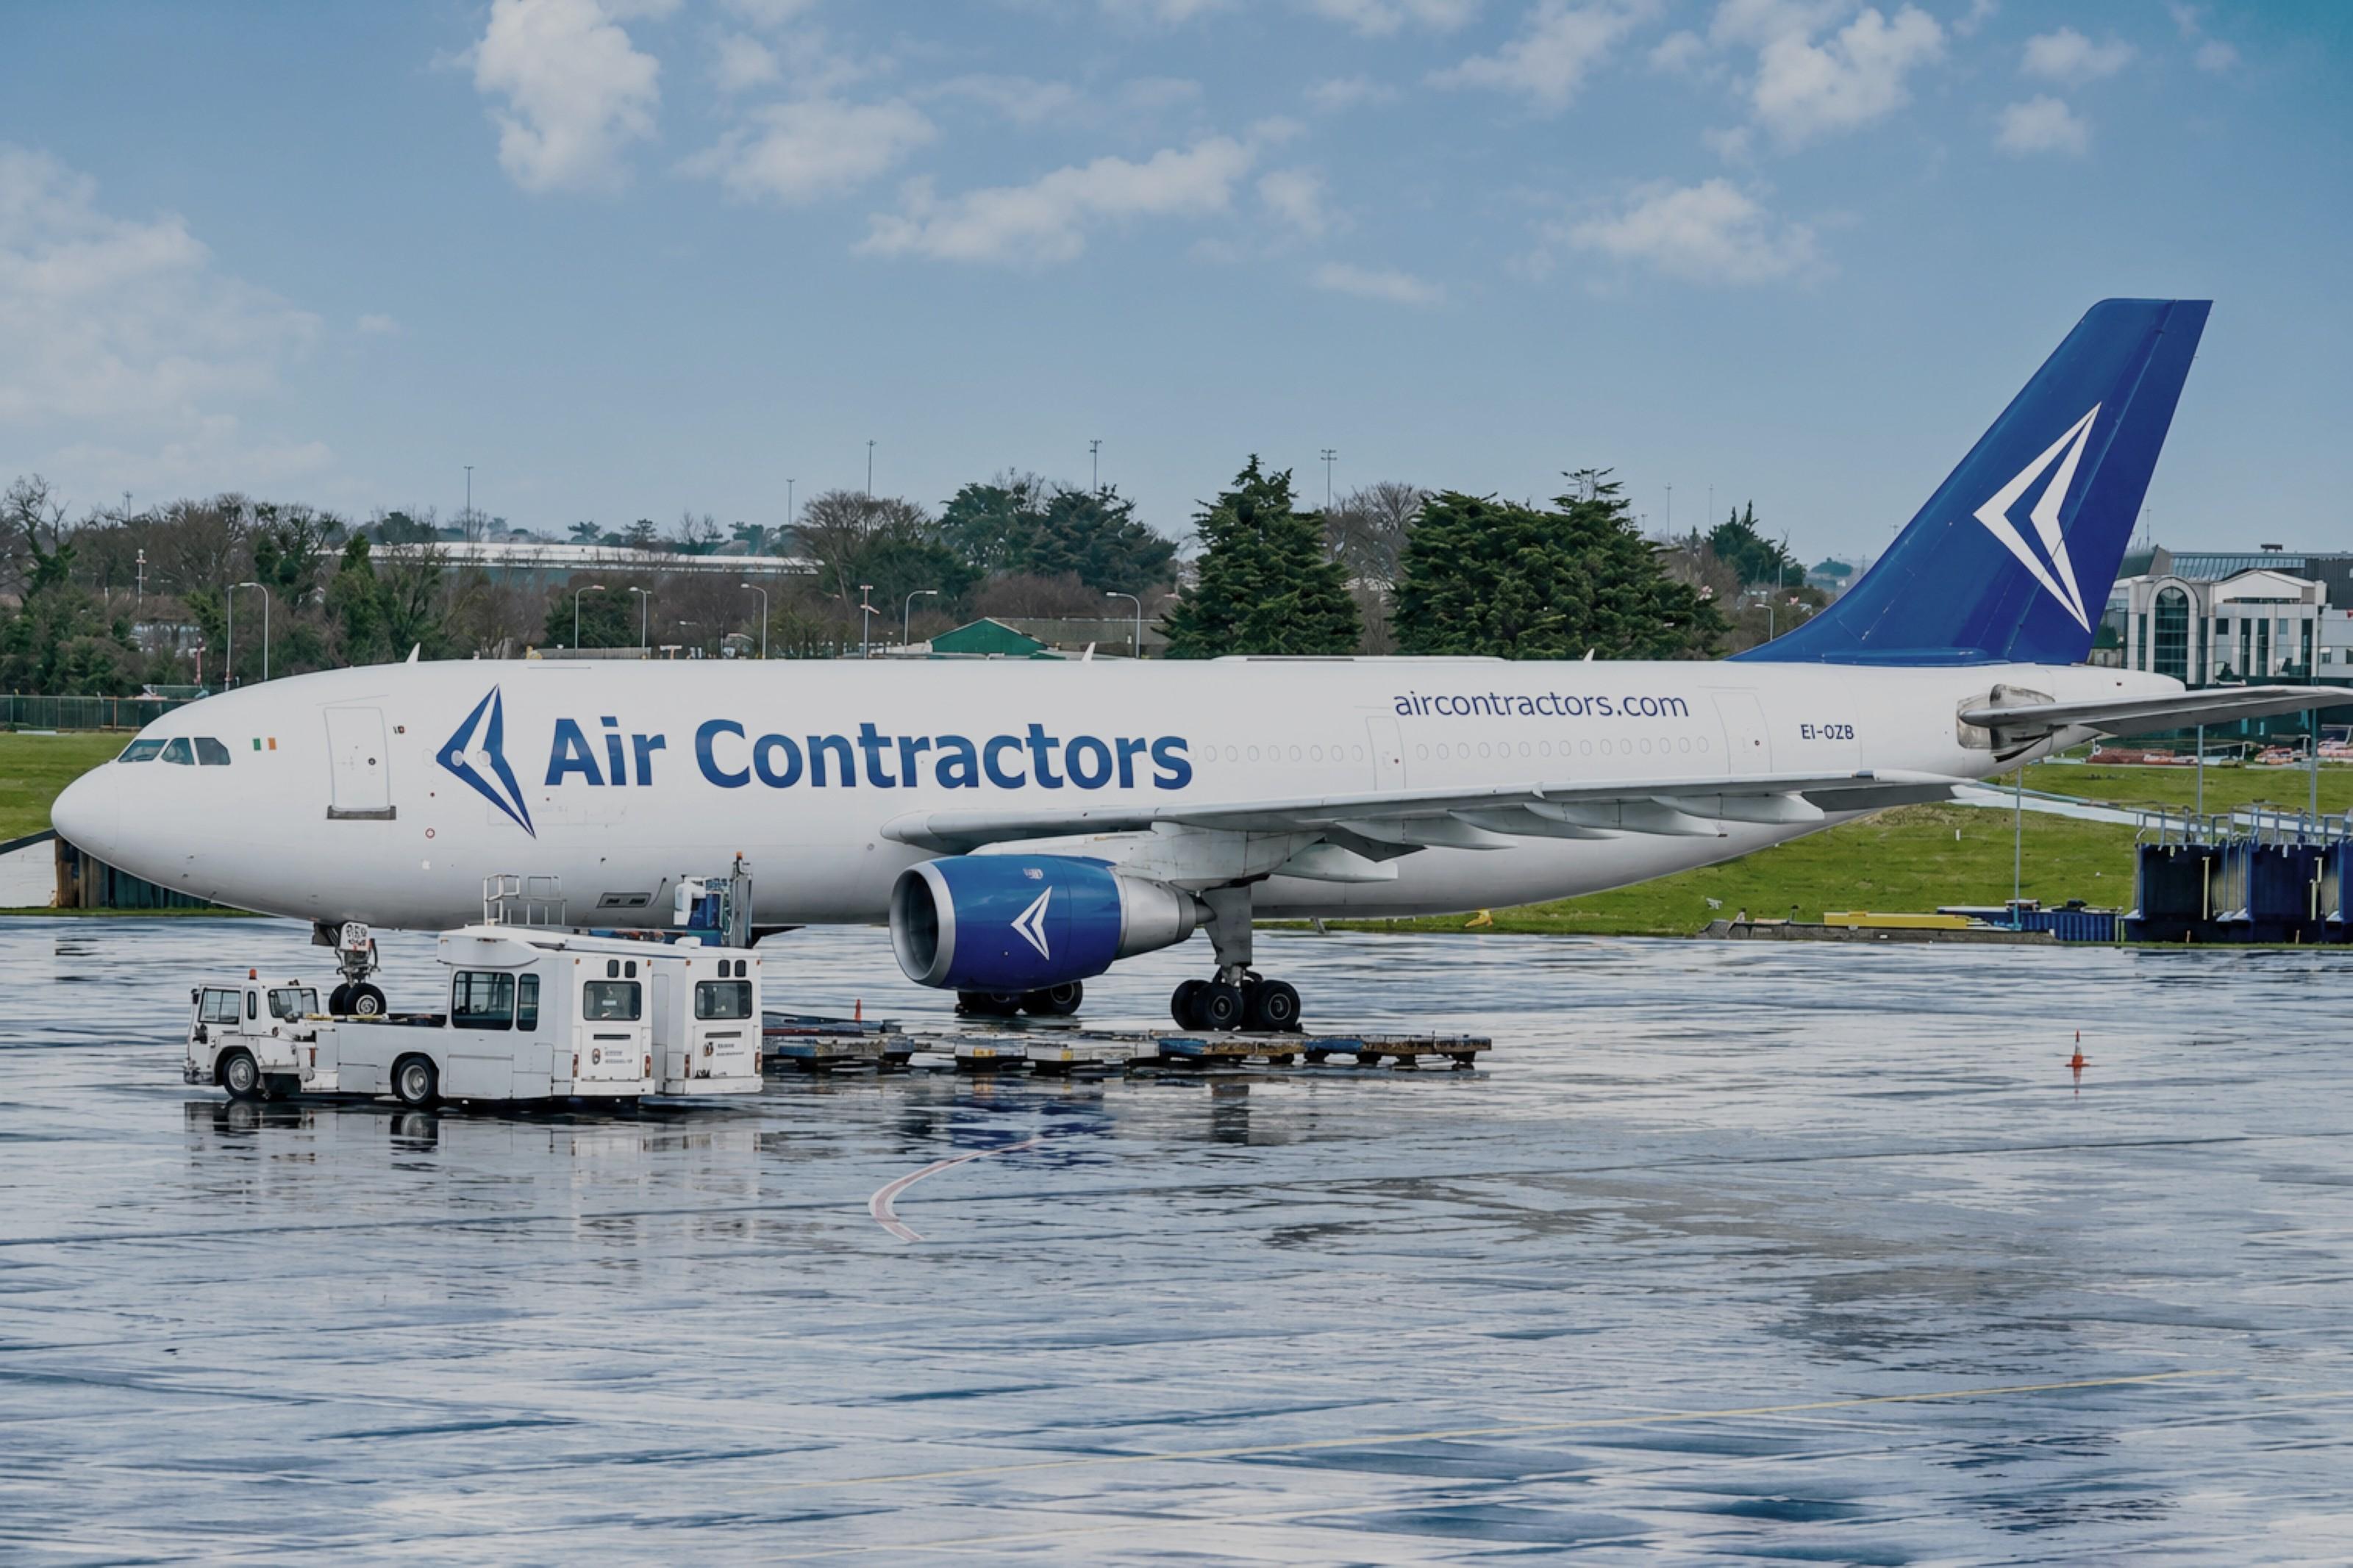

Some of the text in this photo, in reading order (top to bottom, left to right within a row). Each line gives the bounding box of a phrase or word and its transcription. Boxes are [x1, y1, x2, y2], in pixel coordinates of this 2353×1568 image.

[1395, 690, 1689, 717] aircontractors.com
[1800, 724, 1855, 740] EI-OZB
[545, 717, 1192, 790] Air Contractors
